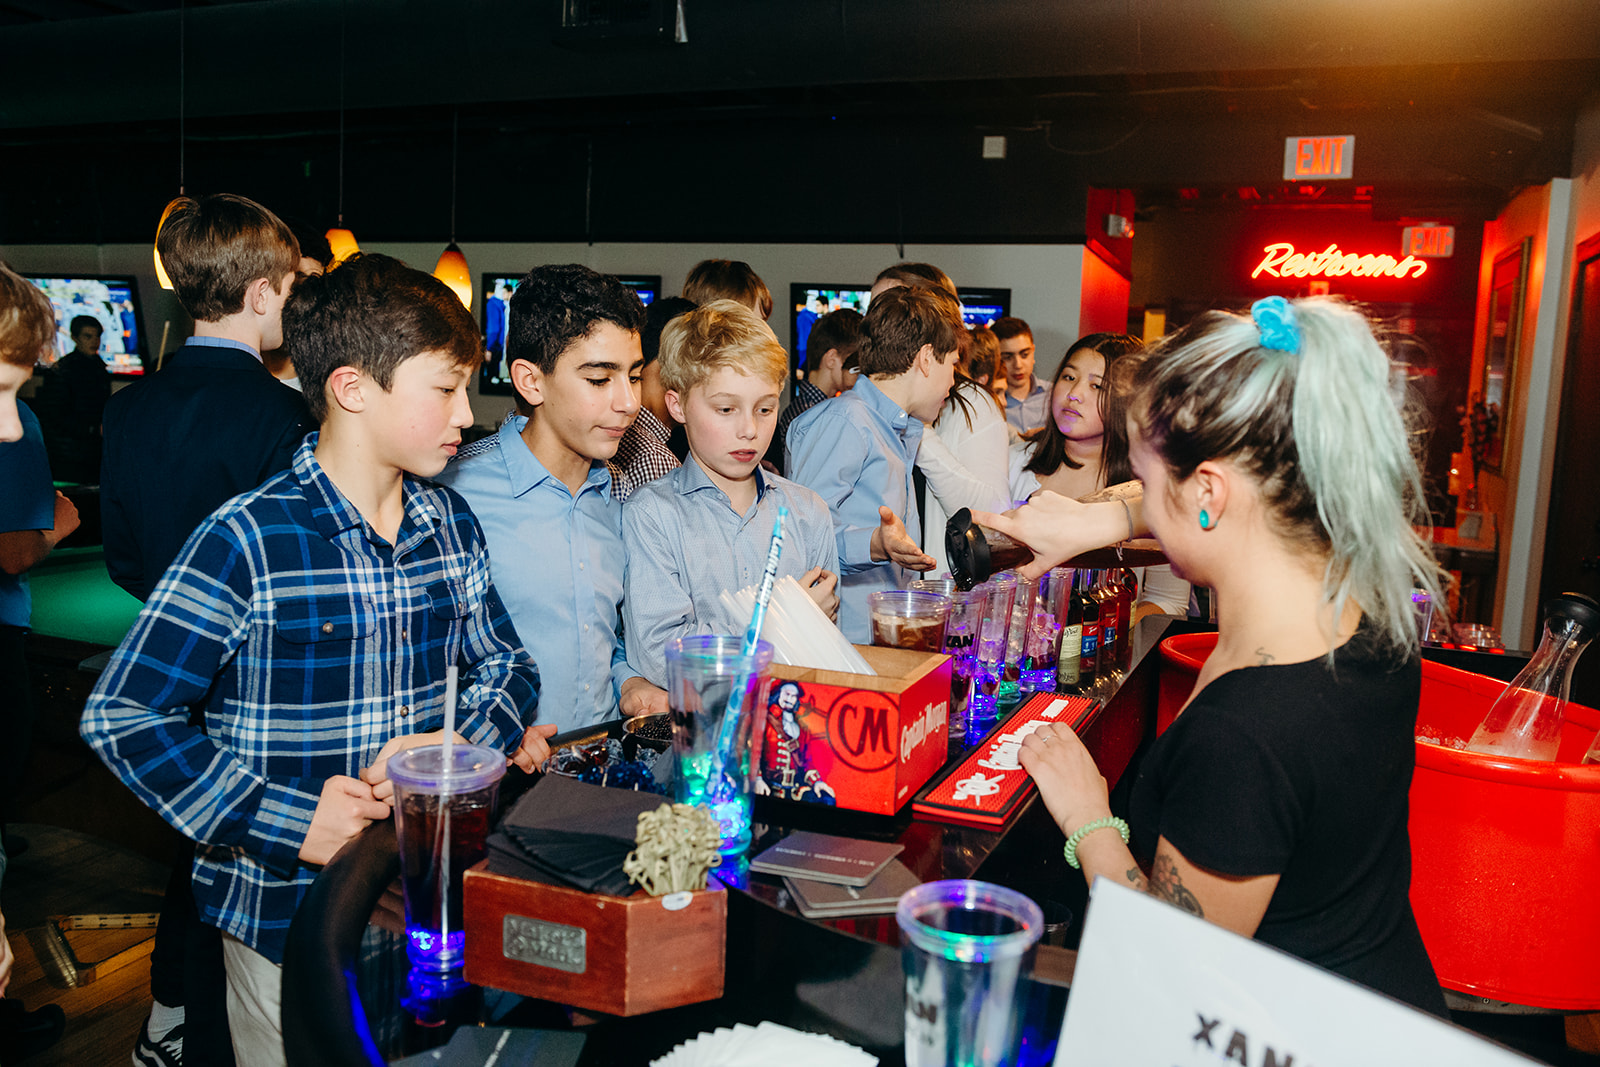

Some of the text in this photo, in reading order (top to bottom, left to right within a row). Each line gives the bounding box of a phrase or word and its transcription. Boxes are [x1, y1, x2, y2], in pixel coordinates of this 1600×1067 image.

[1295, 137, 1347, 175] EXIT
[1410, 226, 1449, 256] EXIT
[1251, 243, 1428, 278] Restrooms
[838, 703, 893, 757] CM
[901, 711, 925, 764] Captain
